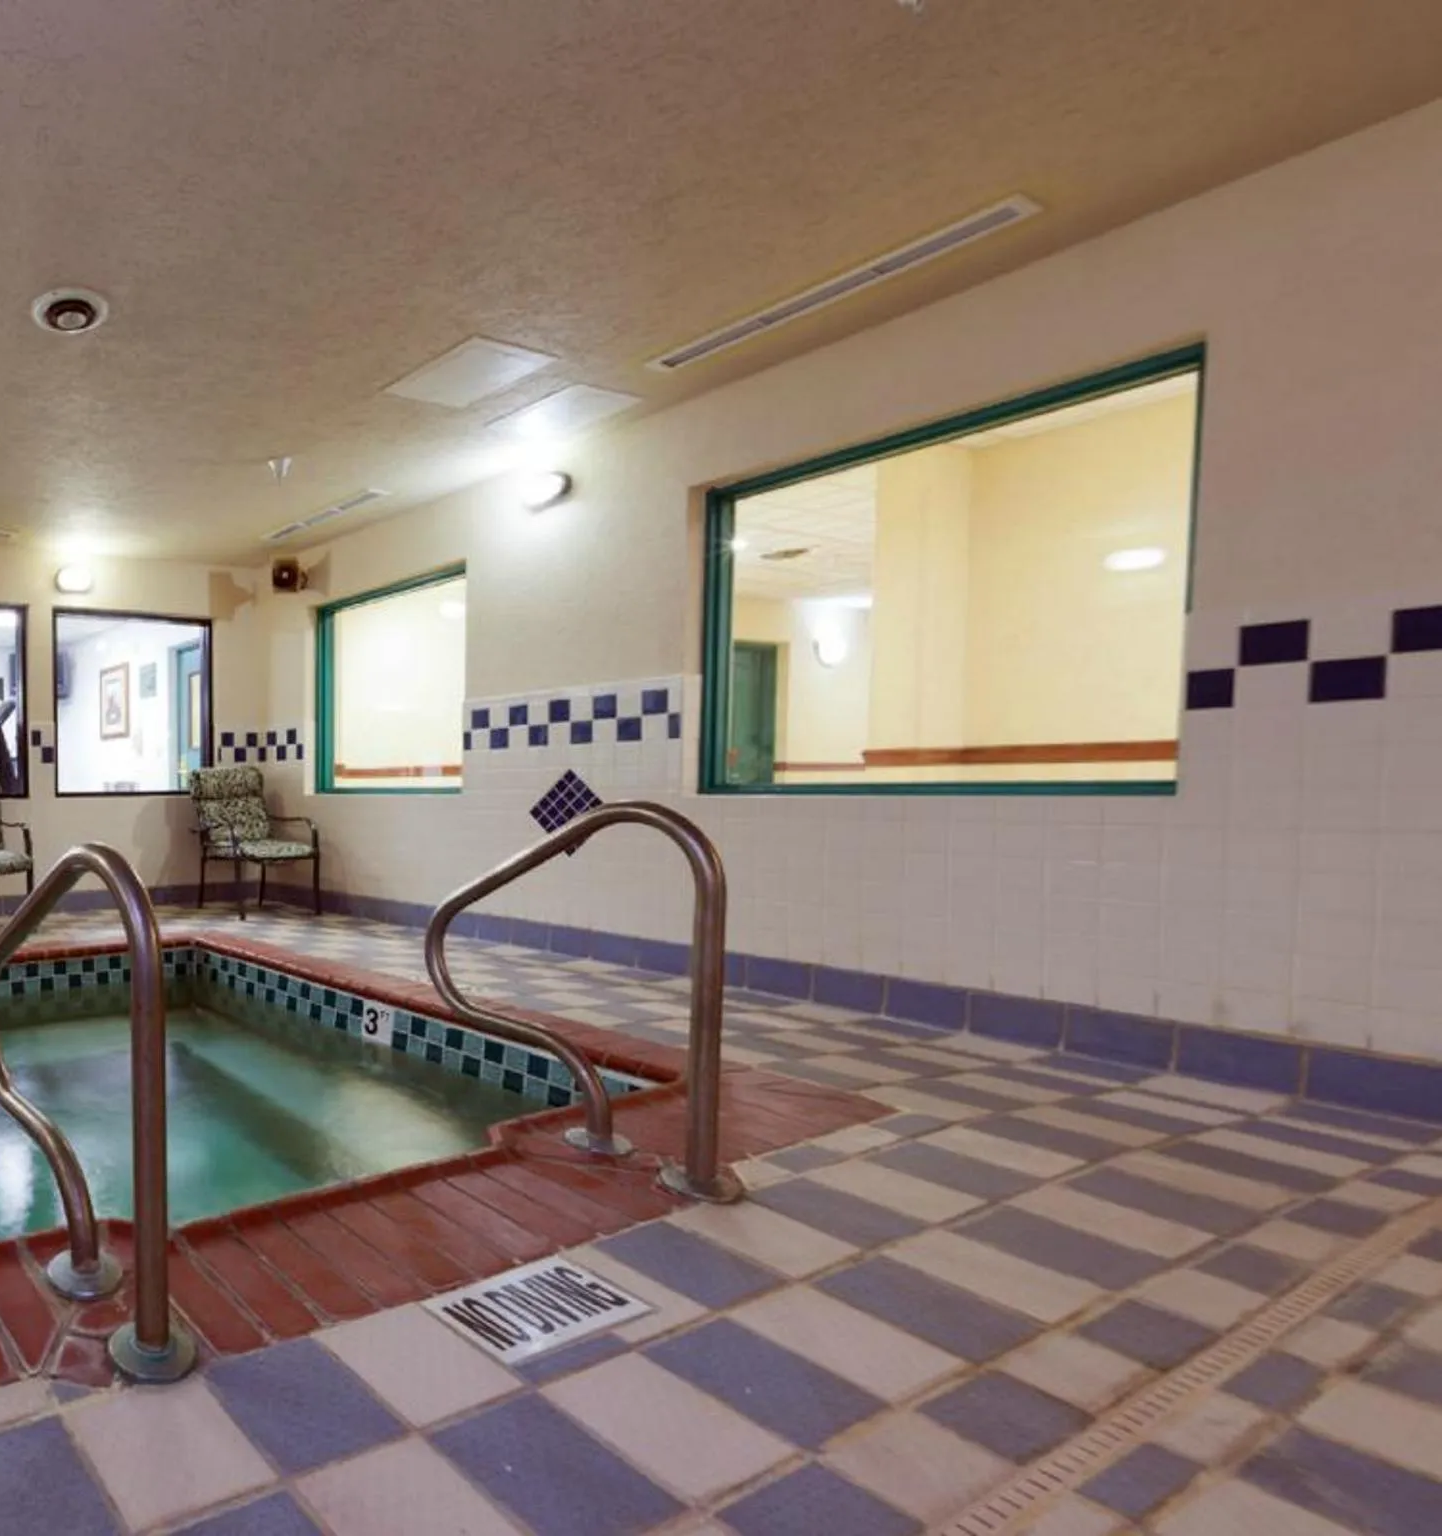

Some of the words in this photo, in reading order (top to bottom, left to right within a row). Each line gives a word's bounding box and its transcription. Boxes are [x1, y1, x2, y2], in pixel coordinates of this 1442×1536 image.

[365, 1008, 378, 1035] 3
[442, 1298, 531, 1351] NO
[483, 1266, 631, 1334] DIVING
